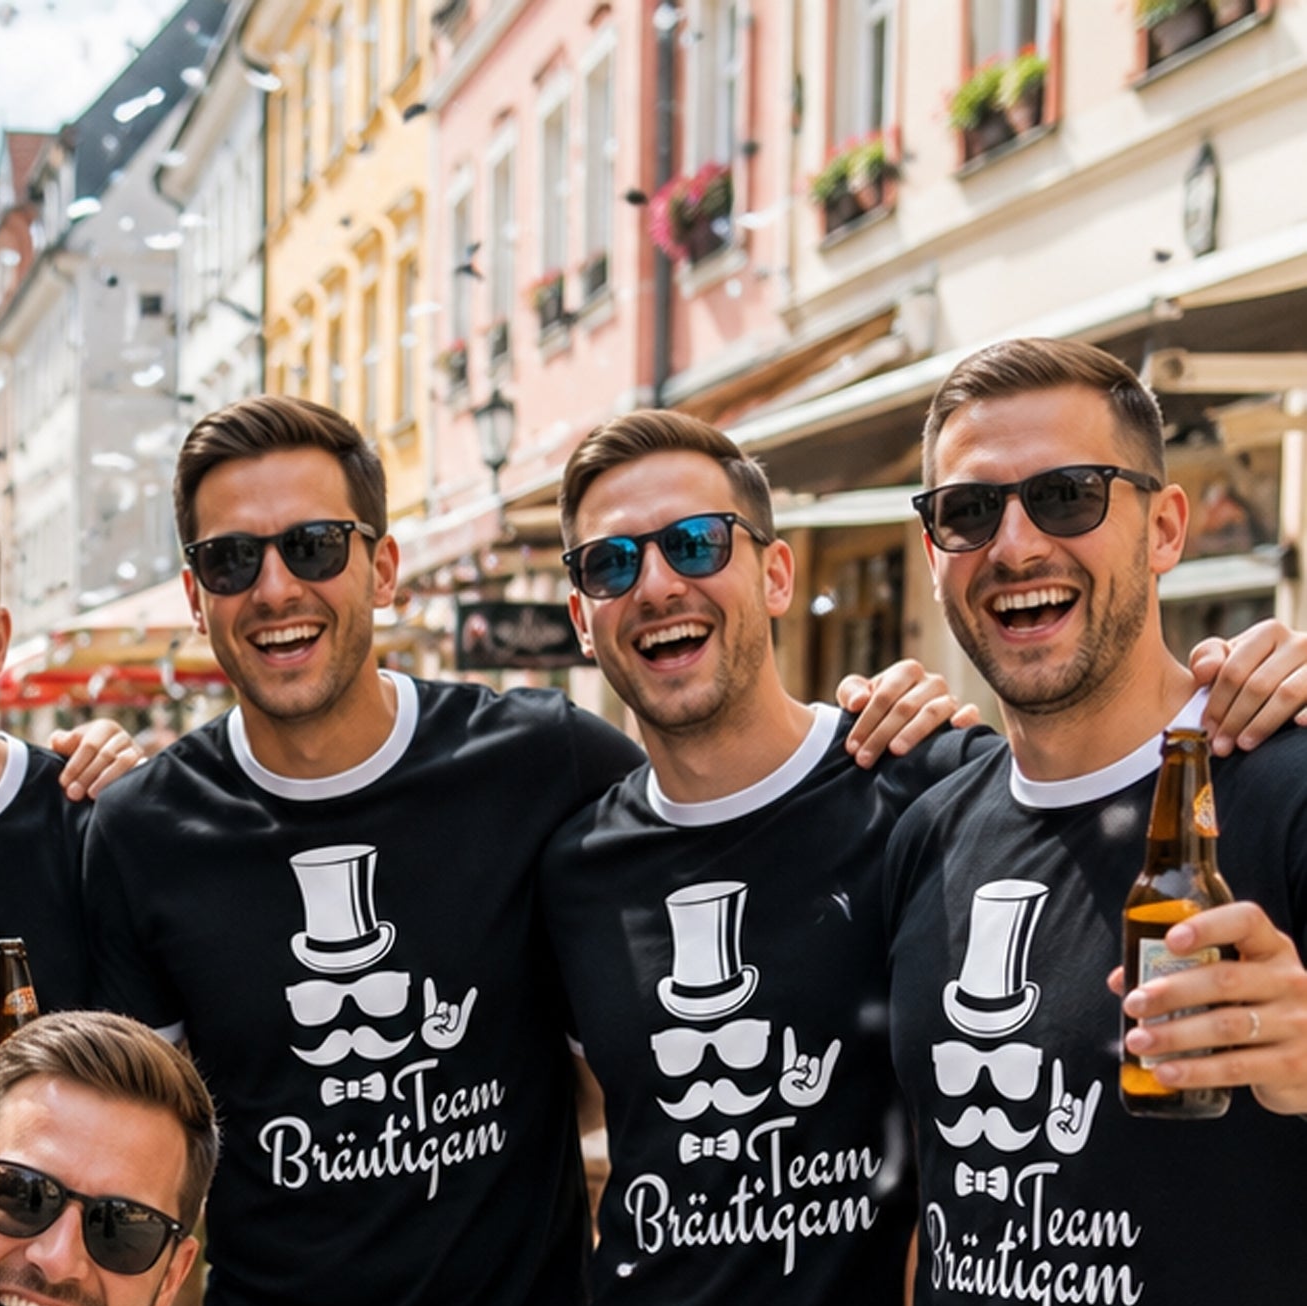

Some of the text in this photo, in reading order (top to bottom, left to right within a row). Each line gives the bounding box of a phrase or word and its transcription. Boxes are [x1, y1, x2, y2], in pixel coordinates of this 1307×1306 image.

[392, 1058, 505, 1132] Team
[258, 1114, 506, 1200] Bräutigam
[746, 1116, 882, 1198] Team
[624, 1173, 879, 1276] Bräutigam
[1013, 1161, 1142, 1252] Team
